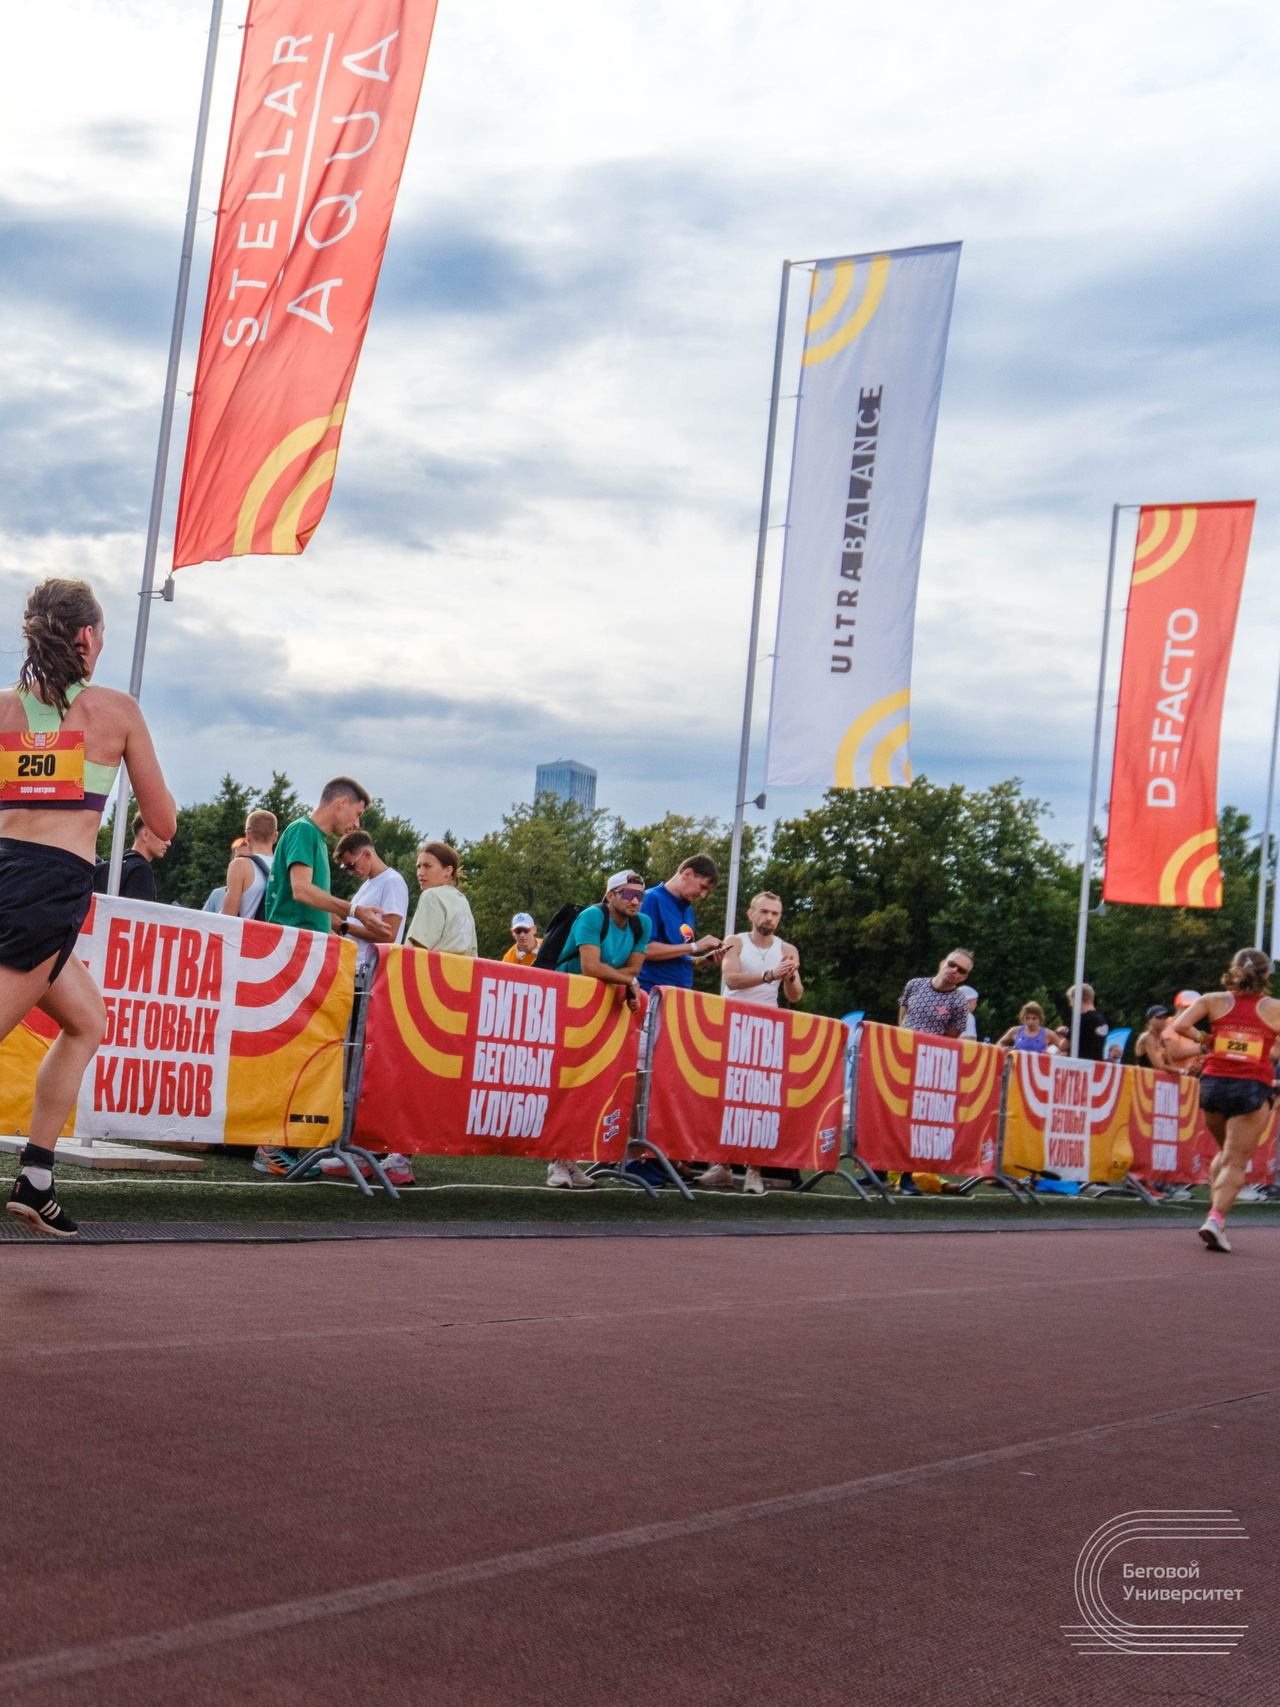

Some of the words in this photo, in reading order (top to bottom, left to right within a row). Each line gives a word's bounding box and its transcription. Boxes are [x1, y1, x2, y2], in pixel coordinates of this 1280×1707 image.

[223, 34, 313, 348] STELLAR
[287, 29, 399, 335] AQUA
[831, 384, 883, 674] ULTRABALANCE
[1146, 607, 1199, 808] DEFACTO
[18, 753, 56, 777] 250
[103, 916, 224, 1003] БИТВА
[99, 995, 221, 1056] БЕГОВЫХ
[477, 976, 557, 1045] БИТВА
[727, 1012, 785, 1070] БИТВА
[93, 1054, 214, 1118] КЛУБОВ
[472, 1041, 554, 1088] БЕГОВЫХ
[724, 1065, 783, 1107] БЕГОВЫХ
[914, 1043, 959, 1092] БИТВА
[465, 1088, 549, 1138] КЛУБОВ
[719, 1105, 781, 1150] КЛУБОВ
